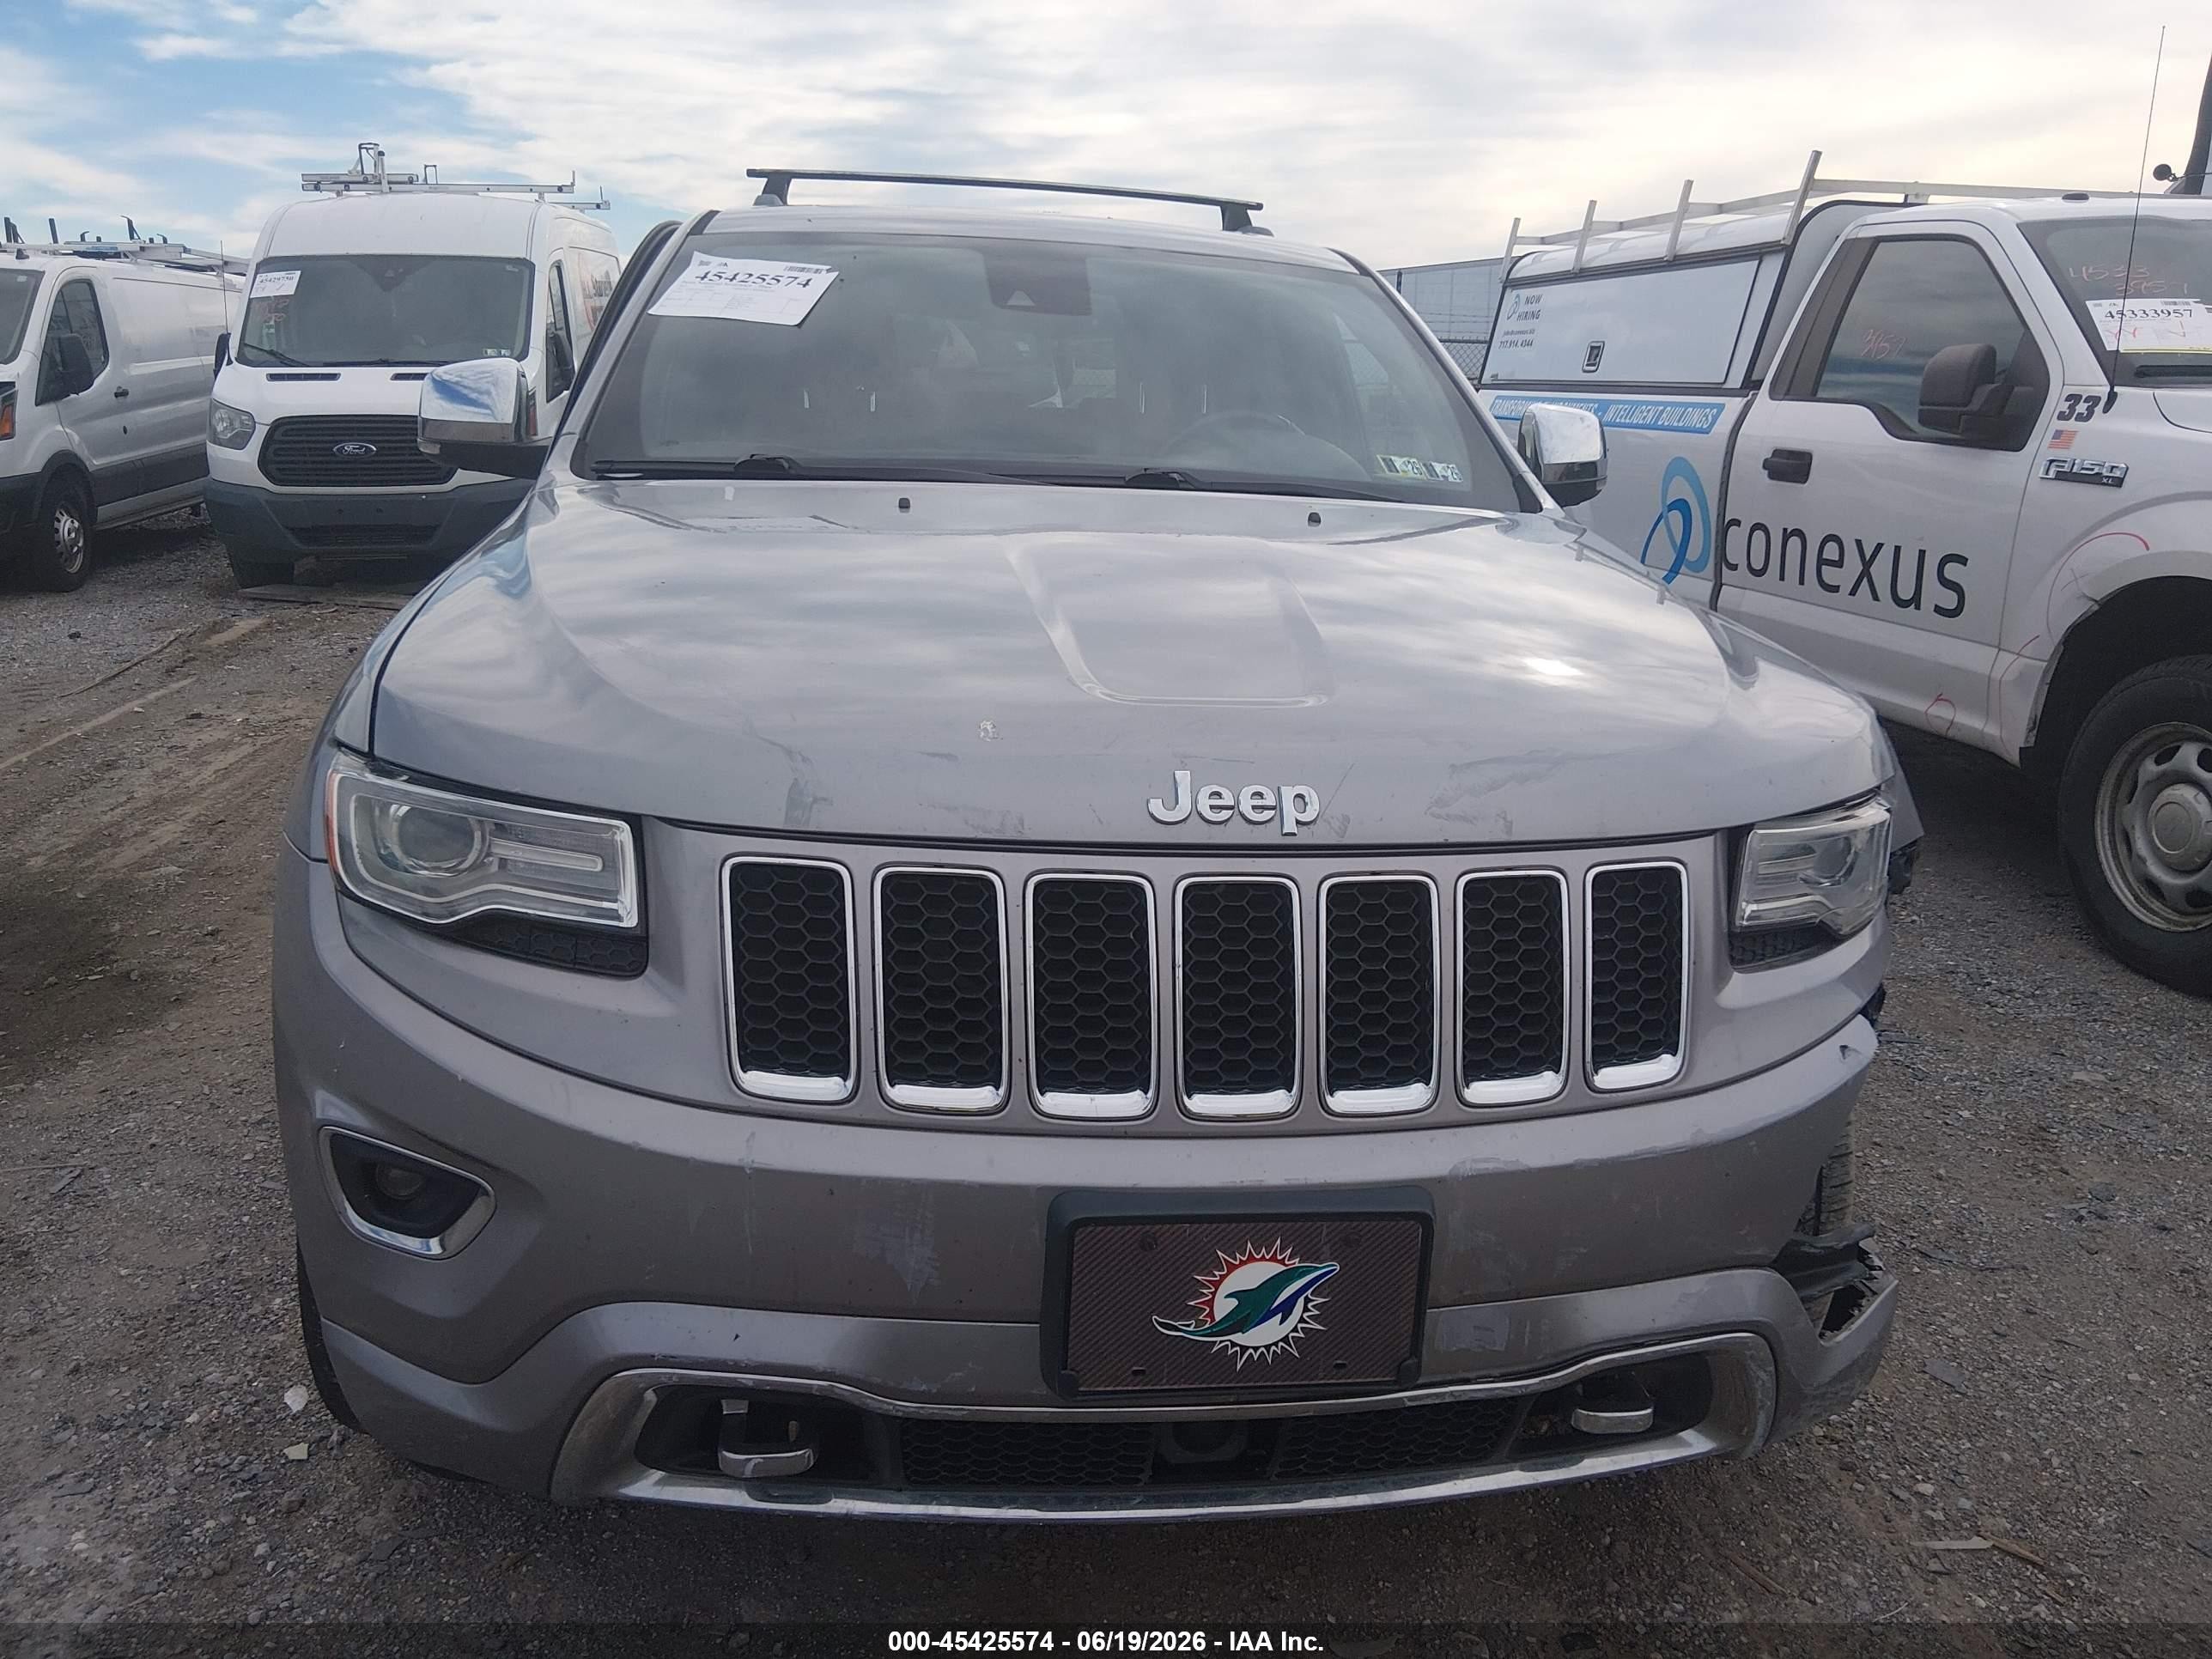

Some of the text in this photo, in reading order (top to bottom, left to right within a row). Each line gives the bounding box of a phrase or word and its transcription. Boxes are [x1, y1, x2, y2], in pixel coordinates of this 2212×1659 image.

[695, 270, 812, 289] 45425574
[1524, 294, 1543, 305] NOW
[1516, 309, 1540, 321] HIRING
[2105, 308, 2193, 319] 45333957
[1602, 404, 1663, 425] INTELLIGENT
[1657, 406, 1717, 428] BUILDINGS
[2057, 393, 2101, 422] 33
[342, 445, 366, 454] Ford
[1723, 518, 1969, 619] conexus
[1147, 770, 1320, 836] Jeep
